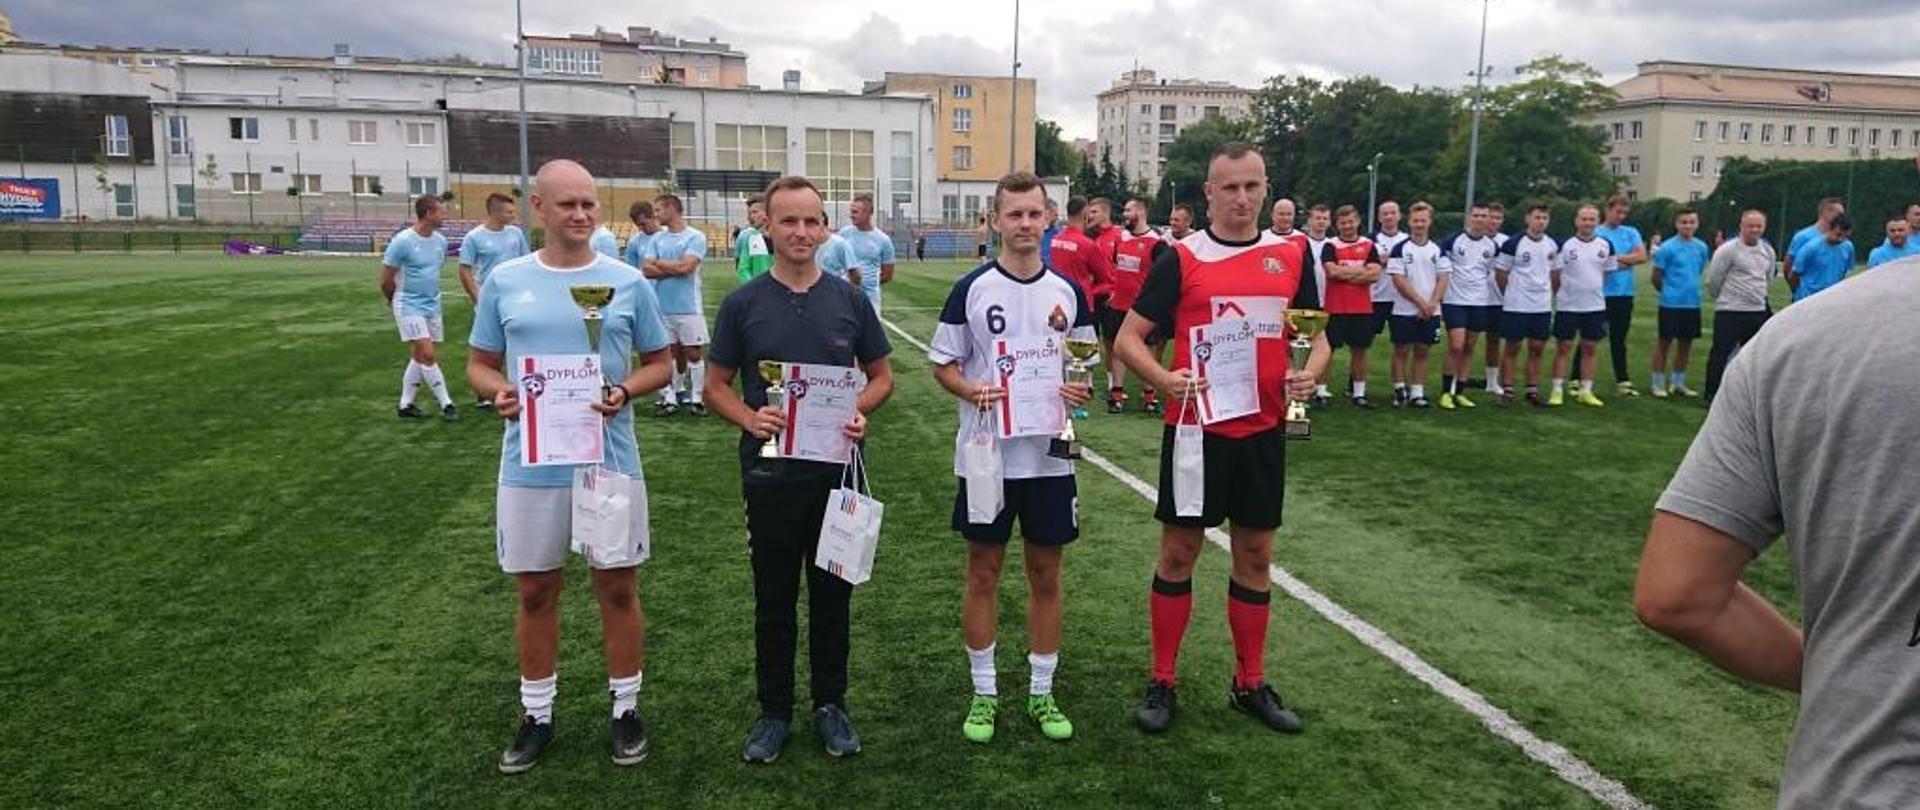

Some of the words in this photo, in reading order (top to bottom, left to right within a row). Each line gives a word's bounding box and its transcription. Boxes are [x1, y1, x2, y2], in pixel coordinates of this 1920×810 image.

[985, 304, 1006, 335] 6
[1015, 347, 1059, 360] DYPLOM
[546, 368, 599, 381] DYPLOM
[809, 376, 856, 390] DYPLOM
